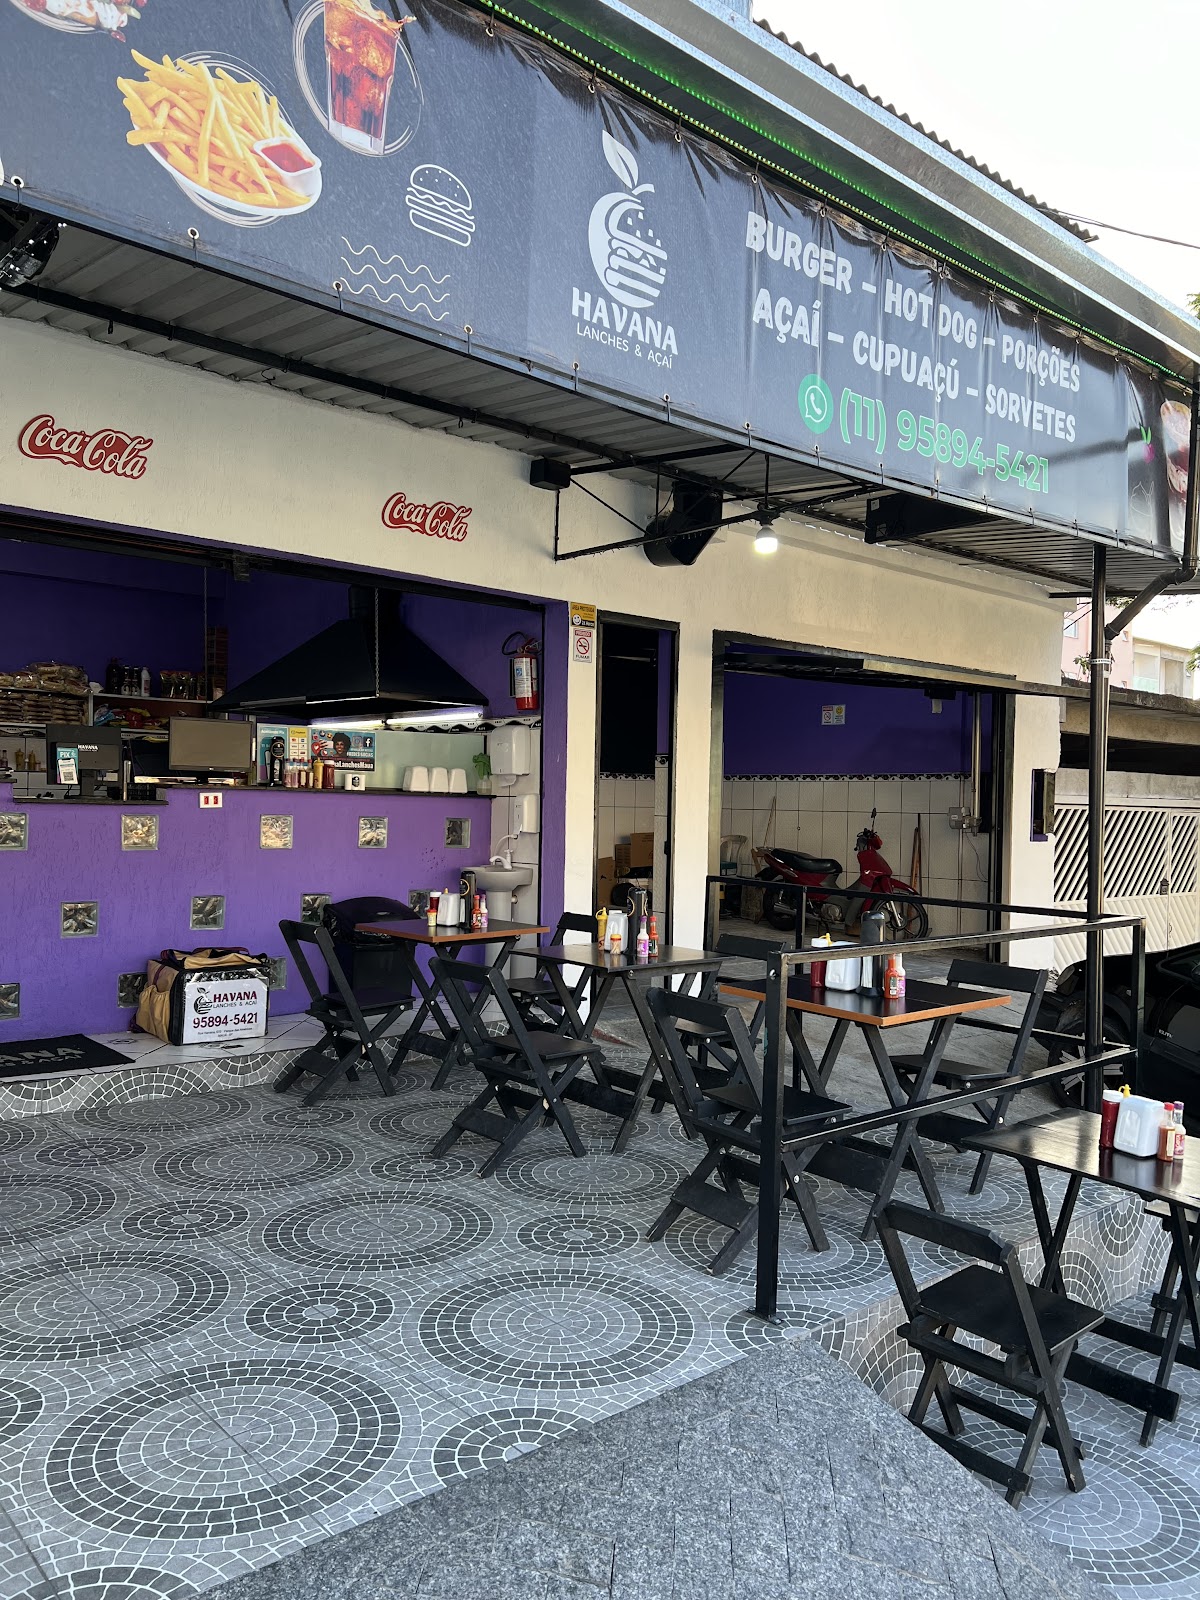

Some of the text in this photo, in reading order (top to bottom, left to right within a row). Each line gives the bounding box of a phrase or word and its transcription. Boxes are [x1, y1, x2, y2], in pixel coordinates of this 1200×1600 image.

[571, 286, 679, 356] HAVANA
[745, 211, 853, 294] BURGER
[884, 278, 934, 329] HOT
[938, 303, 978, 350] DOG
[1001, 334, 1081, 393] PORÇÕES
[576, 322, 674, 370] LANCHES & AÇAÍ
[752, 287, 822, 348] AÇAÍ
[852, 329, 961, 404] CUPUAÇÚ
[984, 383, 1077, 443] SORVETES
[839, 387, 1050, 495] (11) 95894-5421
[192, 1012, 258, 1029] 95894-5421
[213, 990, 258, 1003] HAVANA
